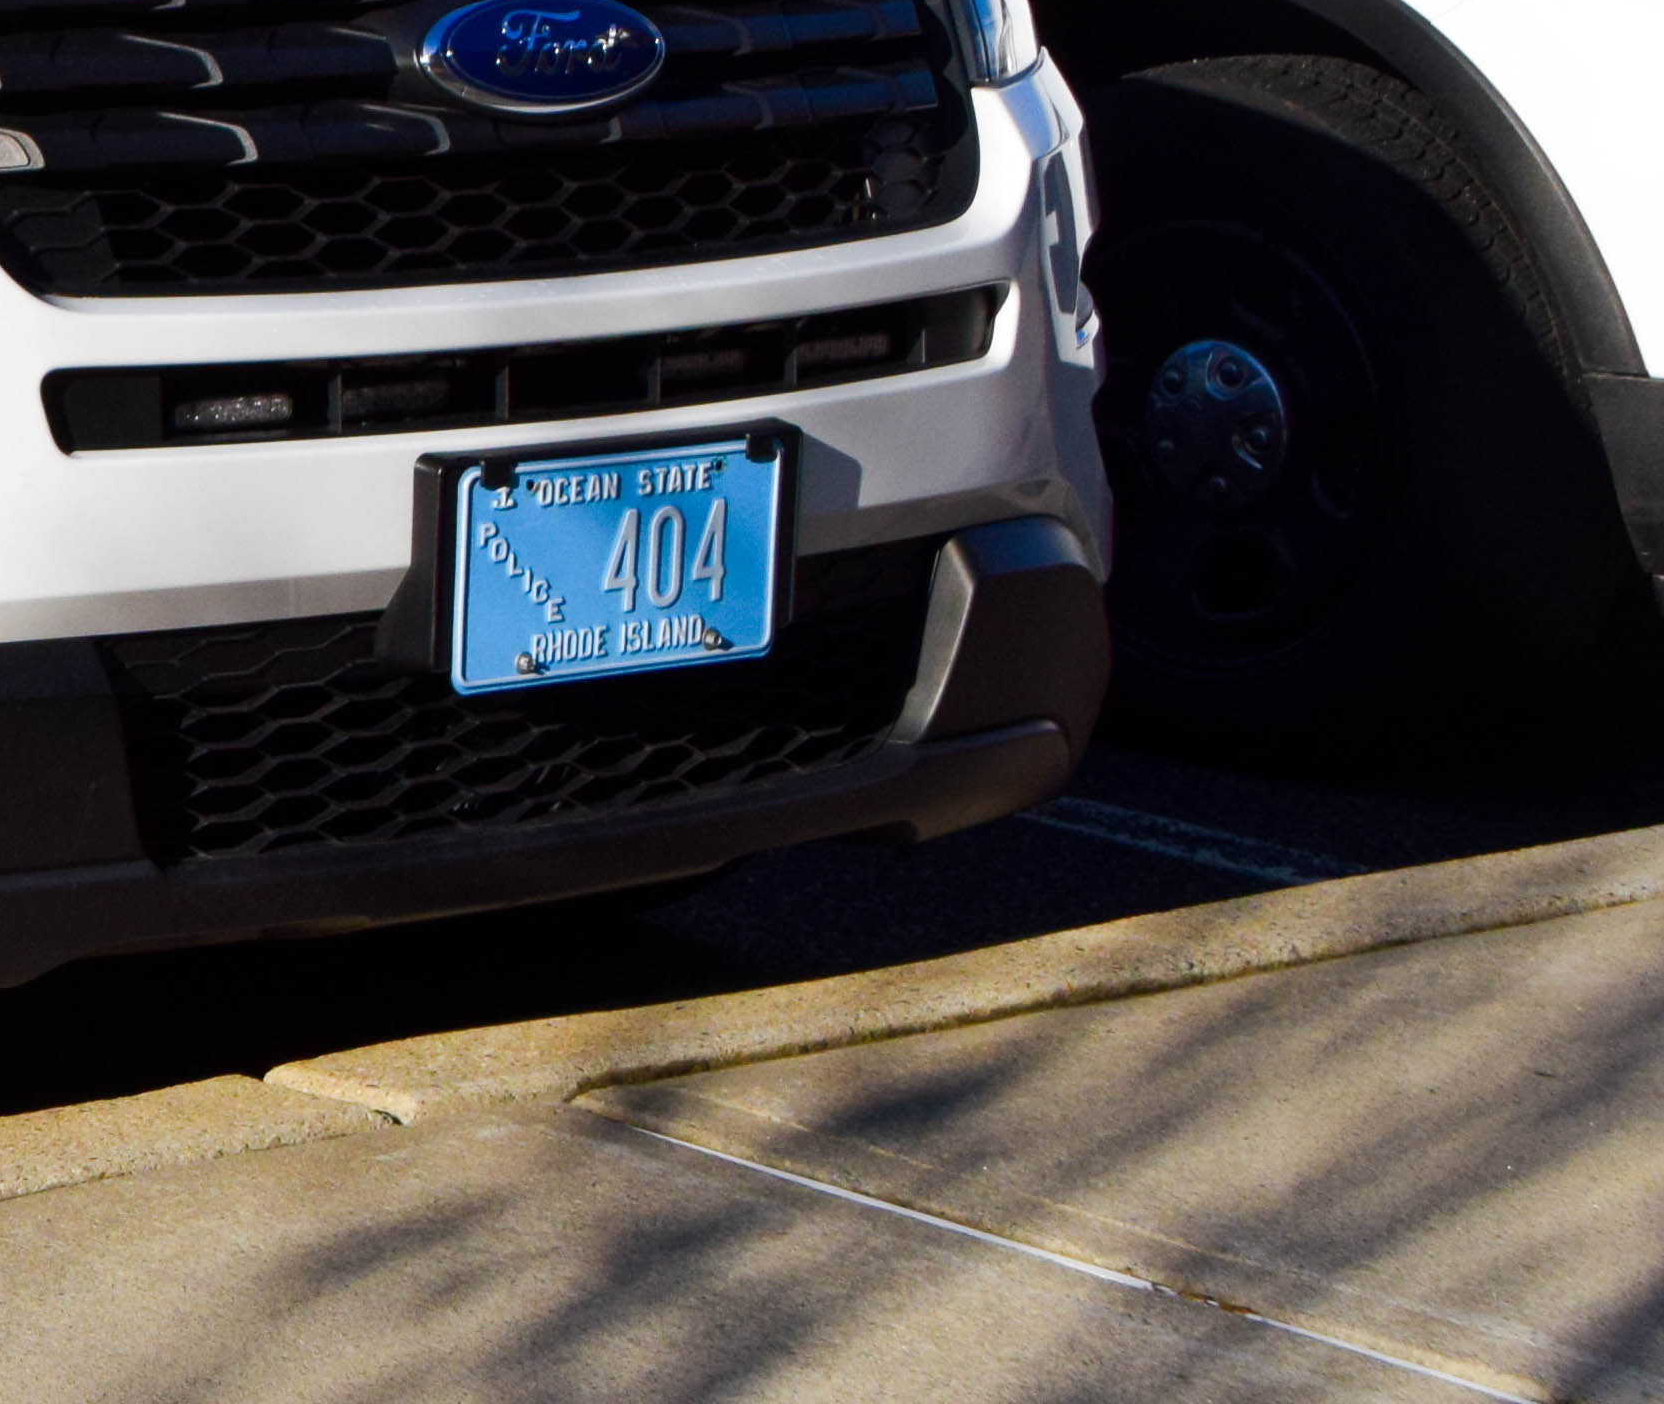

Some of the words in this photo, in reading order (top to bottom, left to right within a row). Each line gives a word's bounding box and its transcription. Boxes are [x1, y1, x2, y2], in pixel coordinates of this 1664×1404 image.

[495, 7, 624, 75] Ford
[536, 471, 620, 509] OCEAN
[637, 460, 713, 496] STATE
[479, 522, 566, 624] POLICE
[601, 497, 727, 613] 404
[530, 625, 610, 666] RHODE
[621, 614, 705, 654] ISLAND
